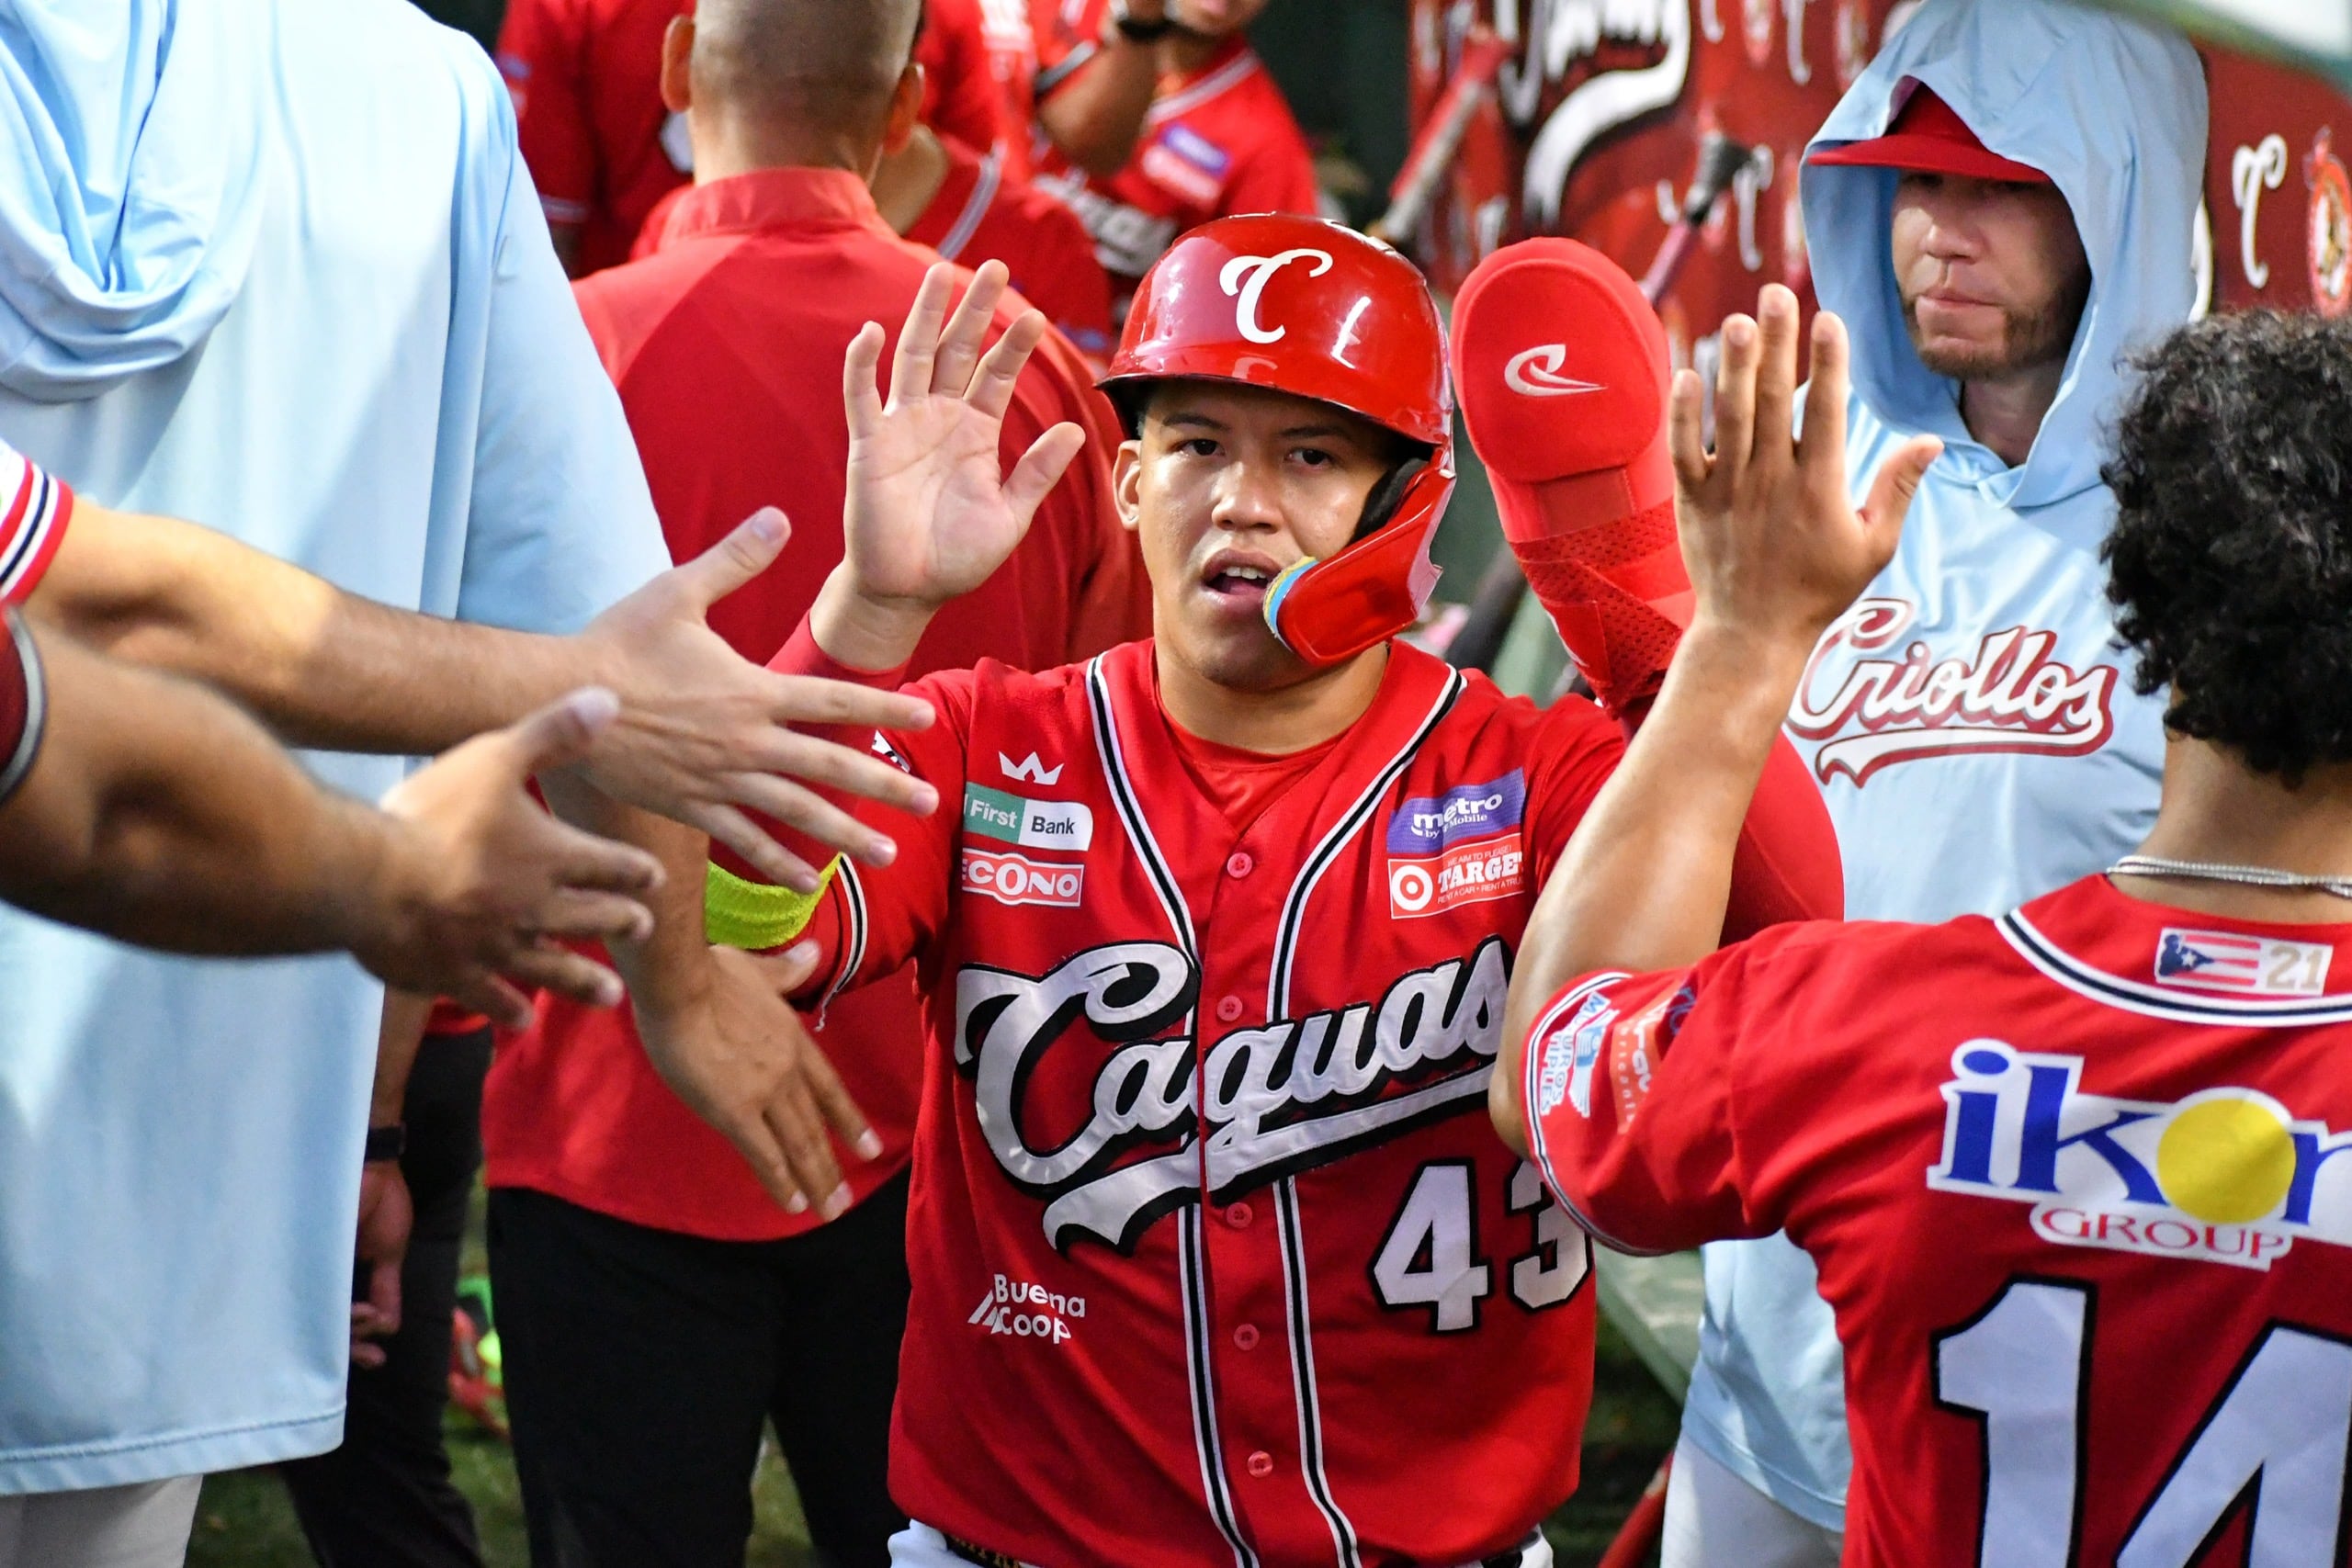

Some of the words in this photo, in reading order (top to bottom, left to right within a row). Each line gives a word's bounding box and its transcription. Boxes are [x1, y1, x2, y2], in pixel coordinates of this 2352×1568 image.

[1785, 597, 2119, 742] Criollos
[969, 799, 1018, 828] First
[1031, 816, 1076, 835] Bank
[1413, 794, 1503, 829] metro
[2266, 943, 2324, 990] 21
[956, 935, 1511, 1203] Caguas
[1370, 1155, 1591, 1333] 43
[2041, 1206, 2285, 1259] GROUP
[994, 1273, 1086, 1317] Buena
[1000, 1306, 1072, 1345] Coop
